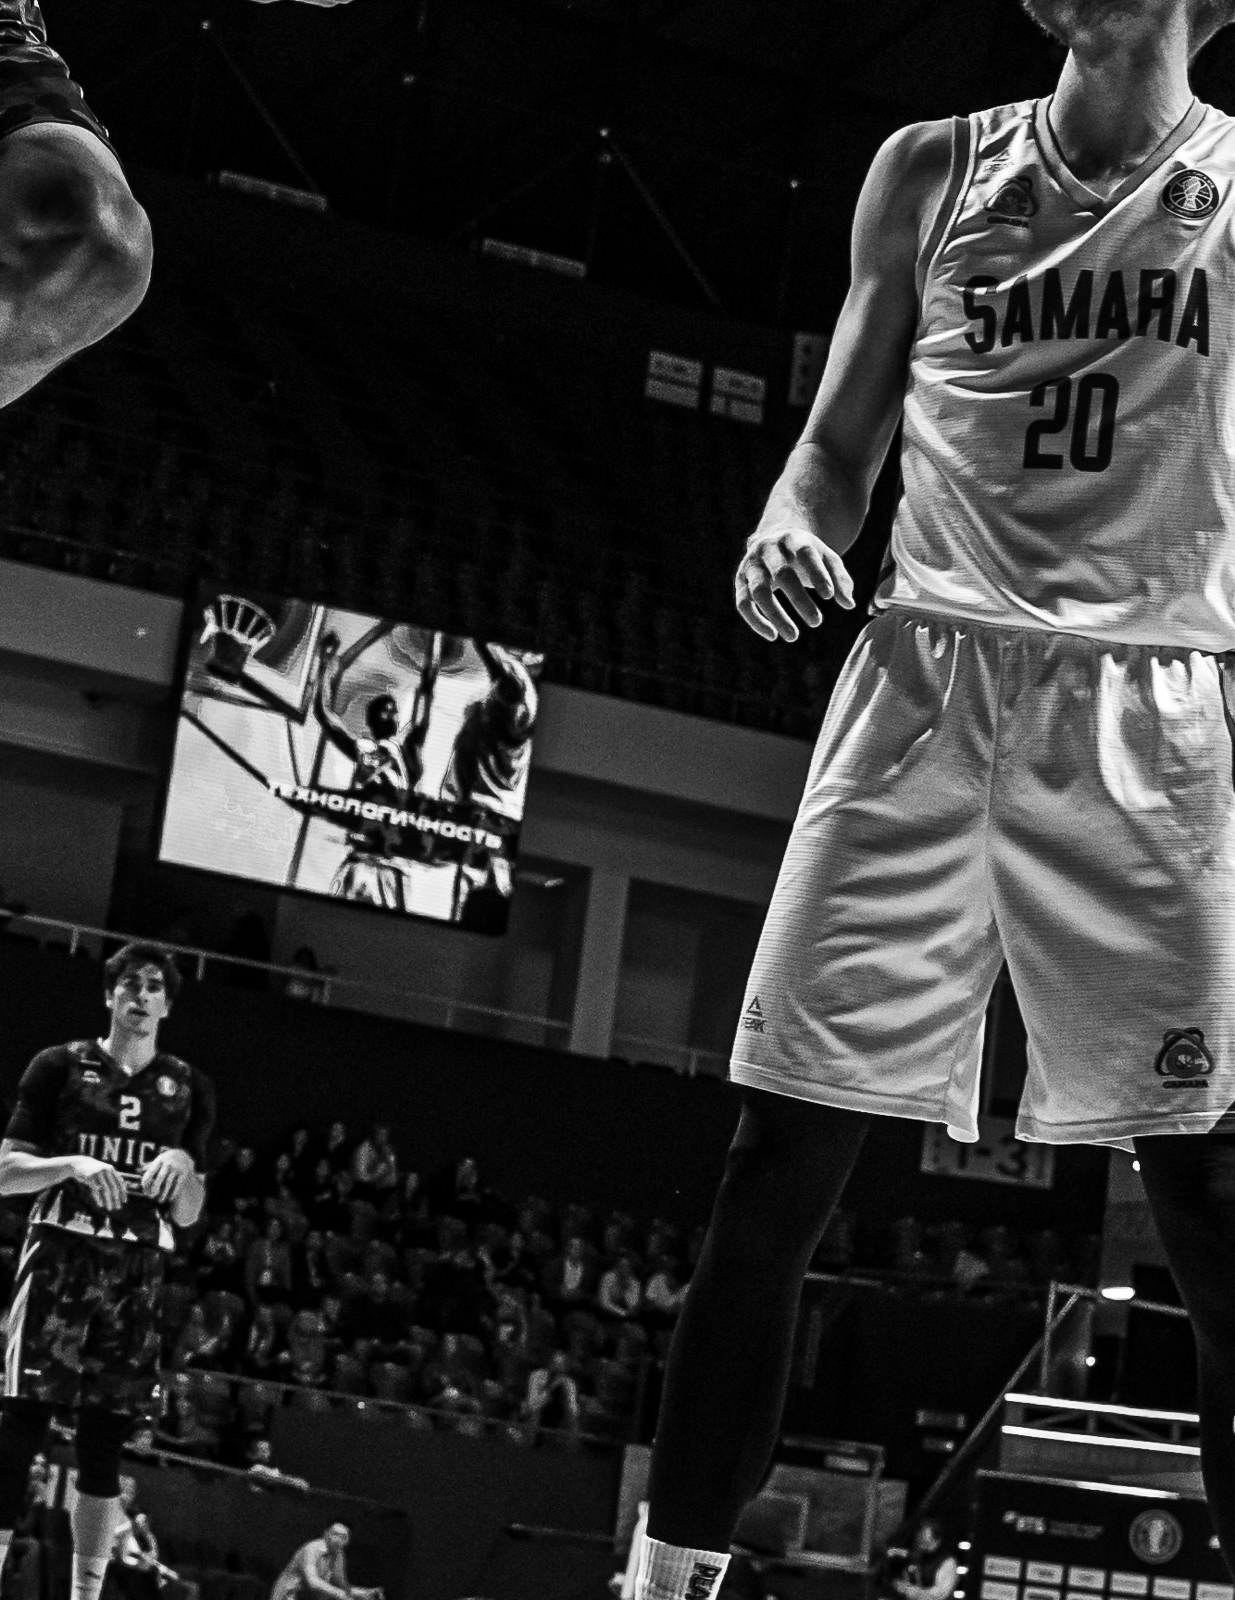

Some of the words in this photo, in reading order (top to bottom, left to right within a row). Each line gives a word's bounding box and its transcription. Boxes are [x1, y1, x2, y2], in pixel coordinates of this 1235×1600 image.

[964, 267, 1210, 357] SAMARA
[1022, 372, 1121, 474] 20
[118, 1094, 142, 1131] 2
[78, 1132, 170, 1169] UNIC
